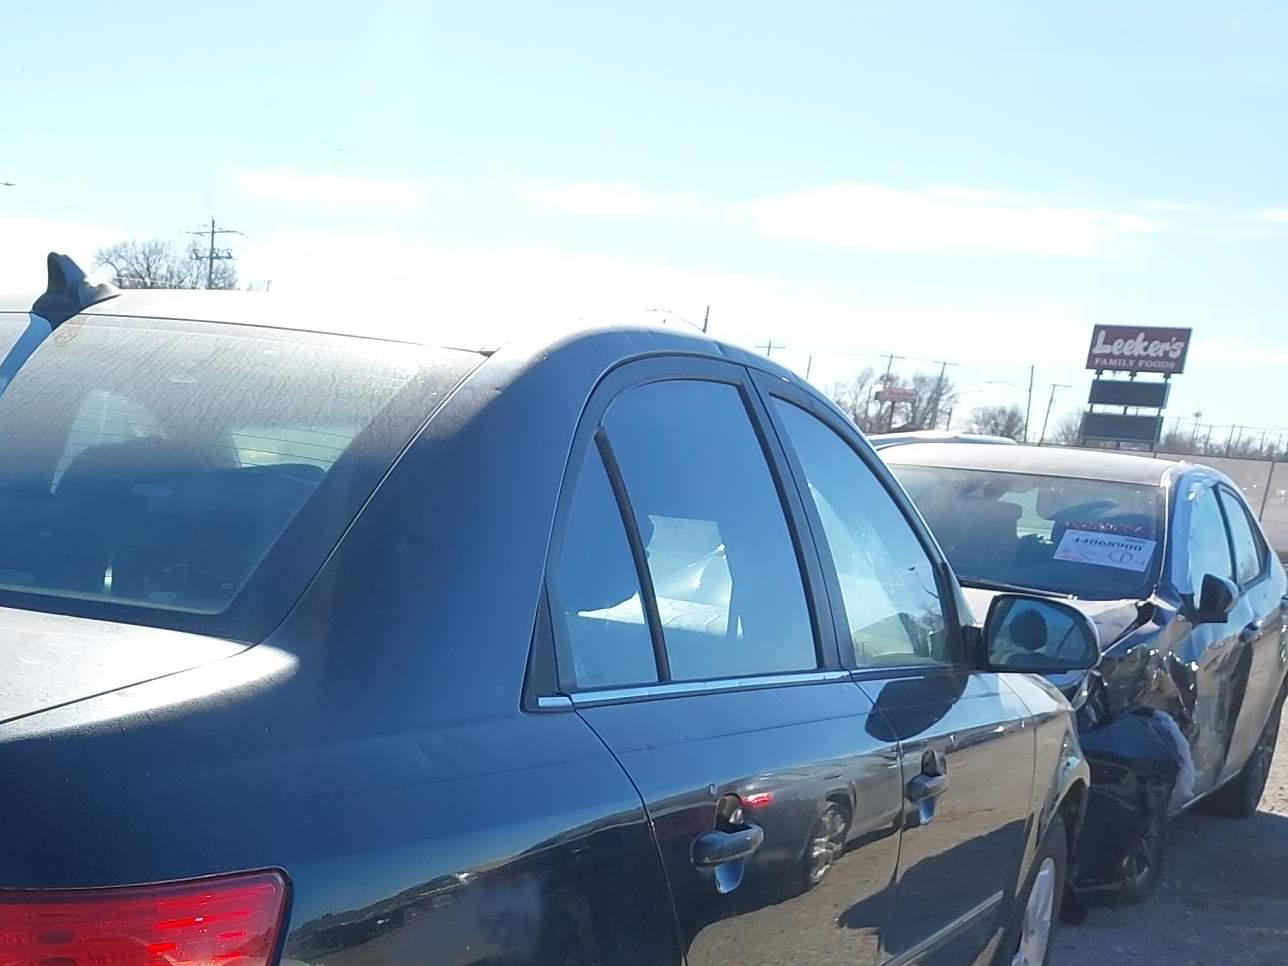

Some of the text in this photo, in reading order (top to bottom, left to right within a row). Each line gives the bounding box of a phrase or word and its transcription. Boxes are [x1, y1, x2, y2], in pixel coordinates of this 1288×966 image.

[1093, 329, 1185, 359] Leeker's
[1094, 357, 1176, 369] FAMILY FOODS
